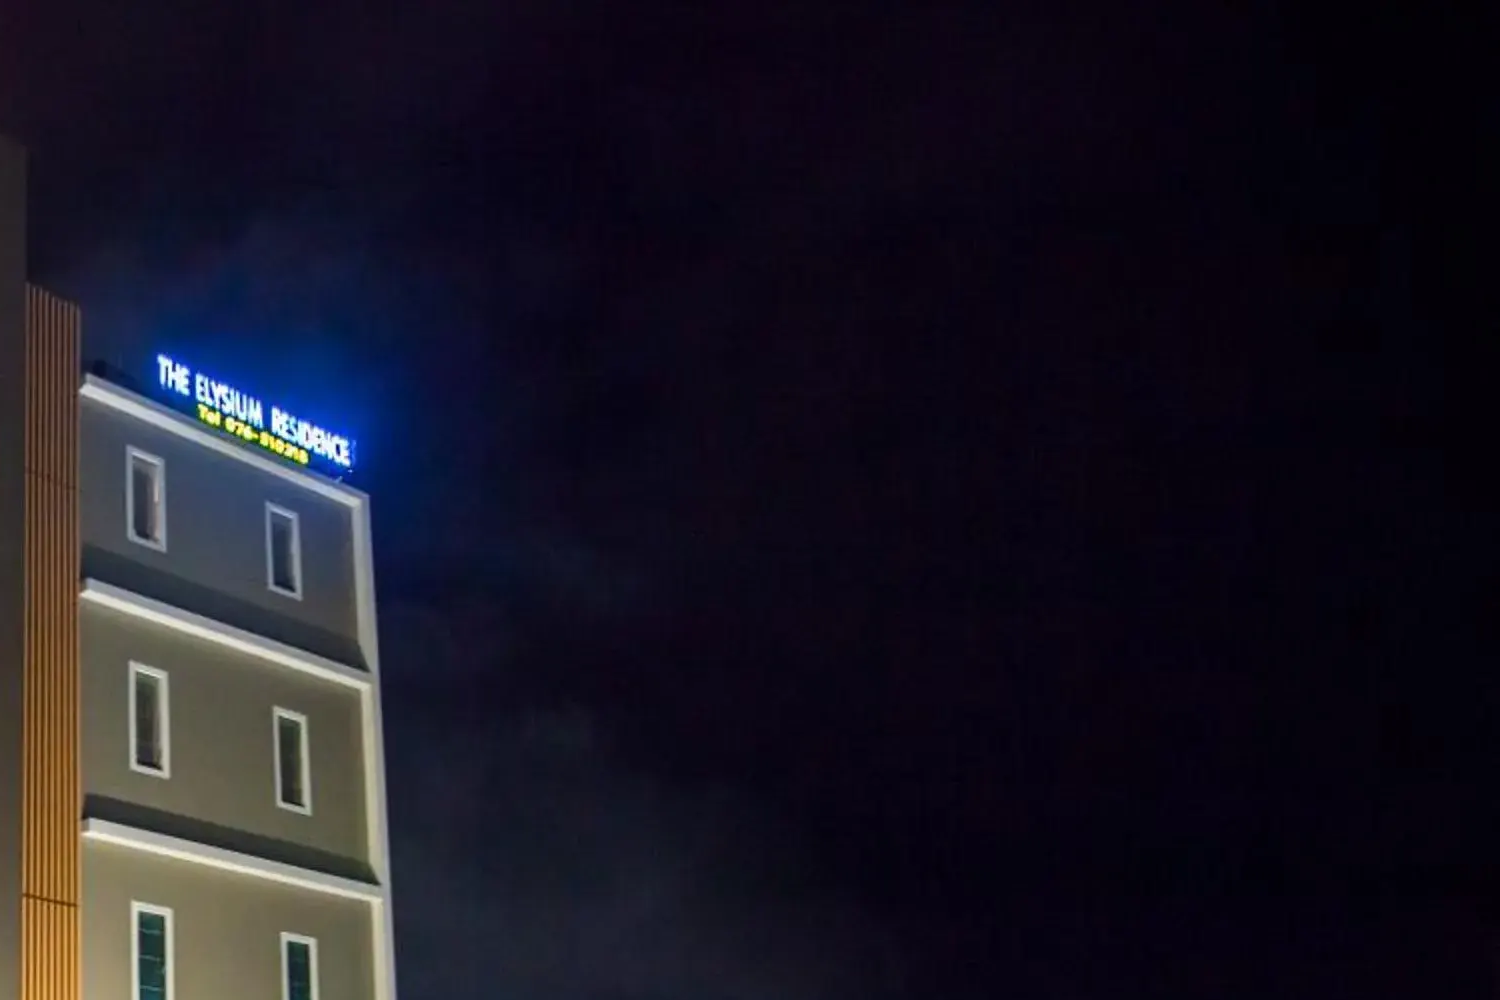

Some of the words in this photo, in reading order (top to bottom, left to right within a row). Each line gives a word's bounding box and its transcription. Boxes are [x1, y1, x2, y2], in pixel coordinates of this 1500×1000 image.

[157, 353, 191, 396] THE
[195, 373, 264, 429] ELYSIUM
[271, 404, 353, 467] RESIDENCE
